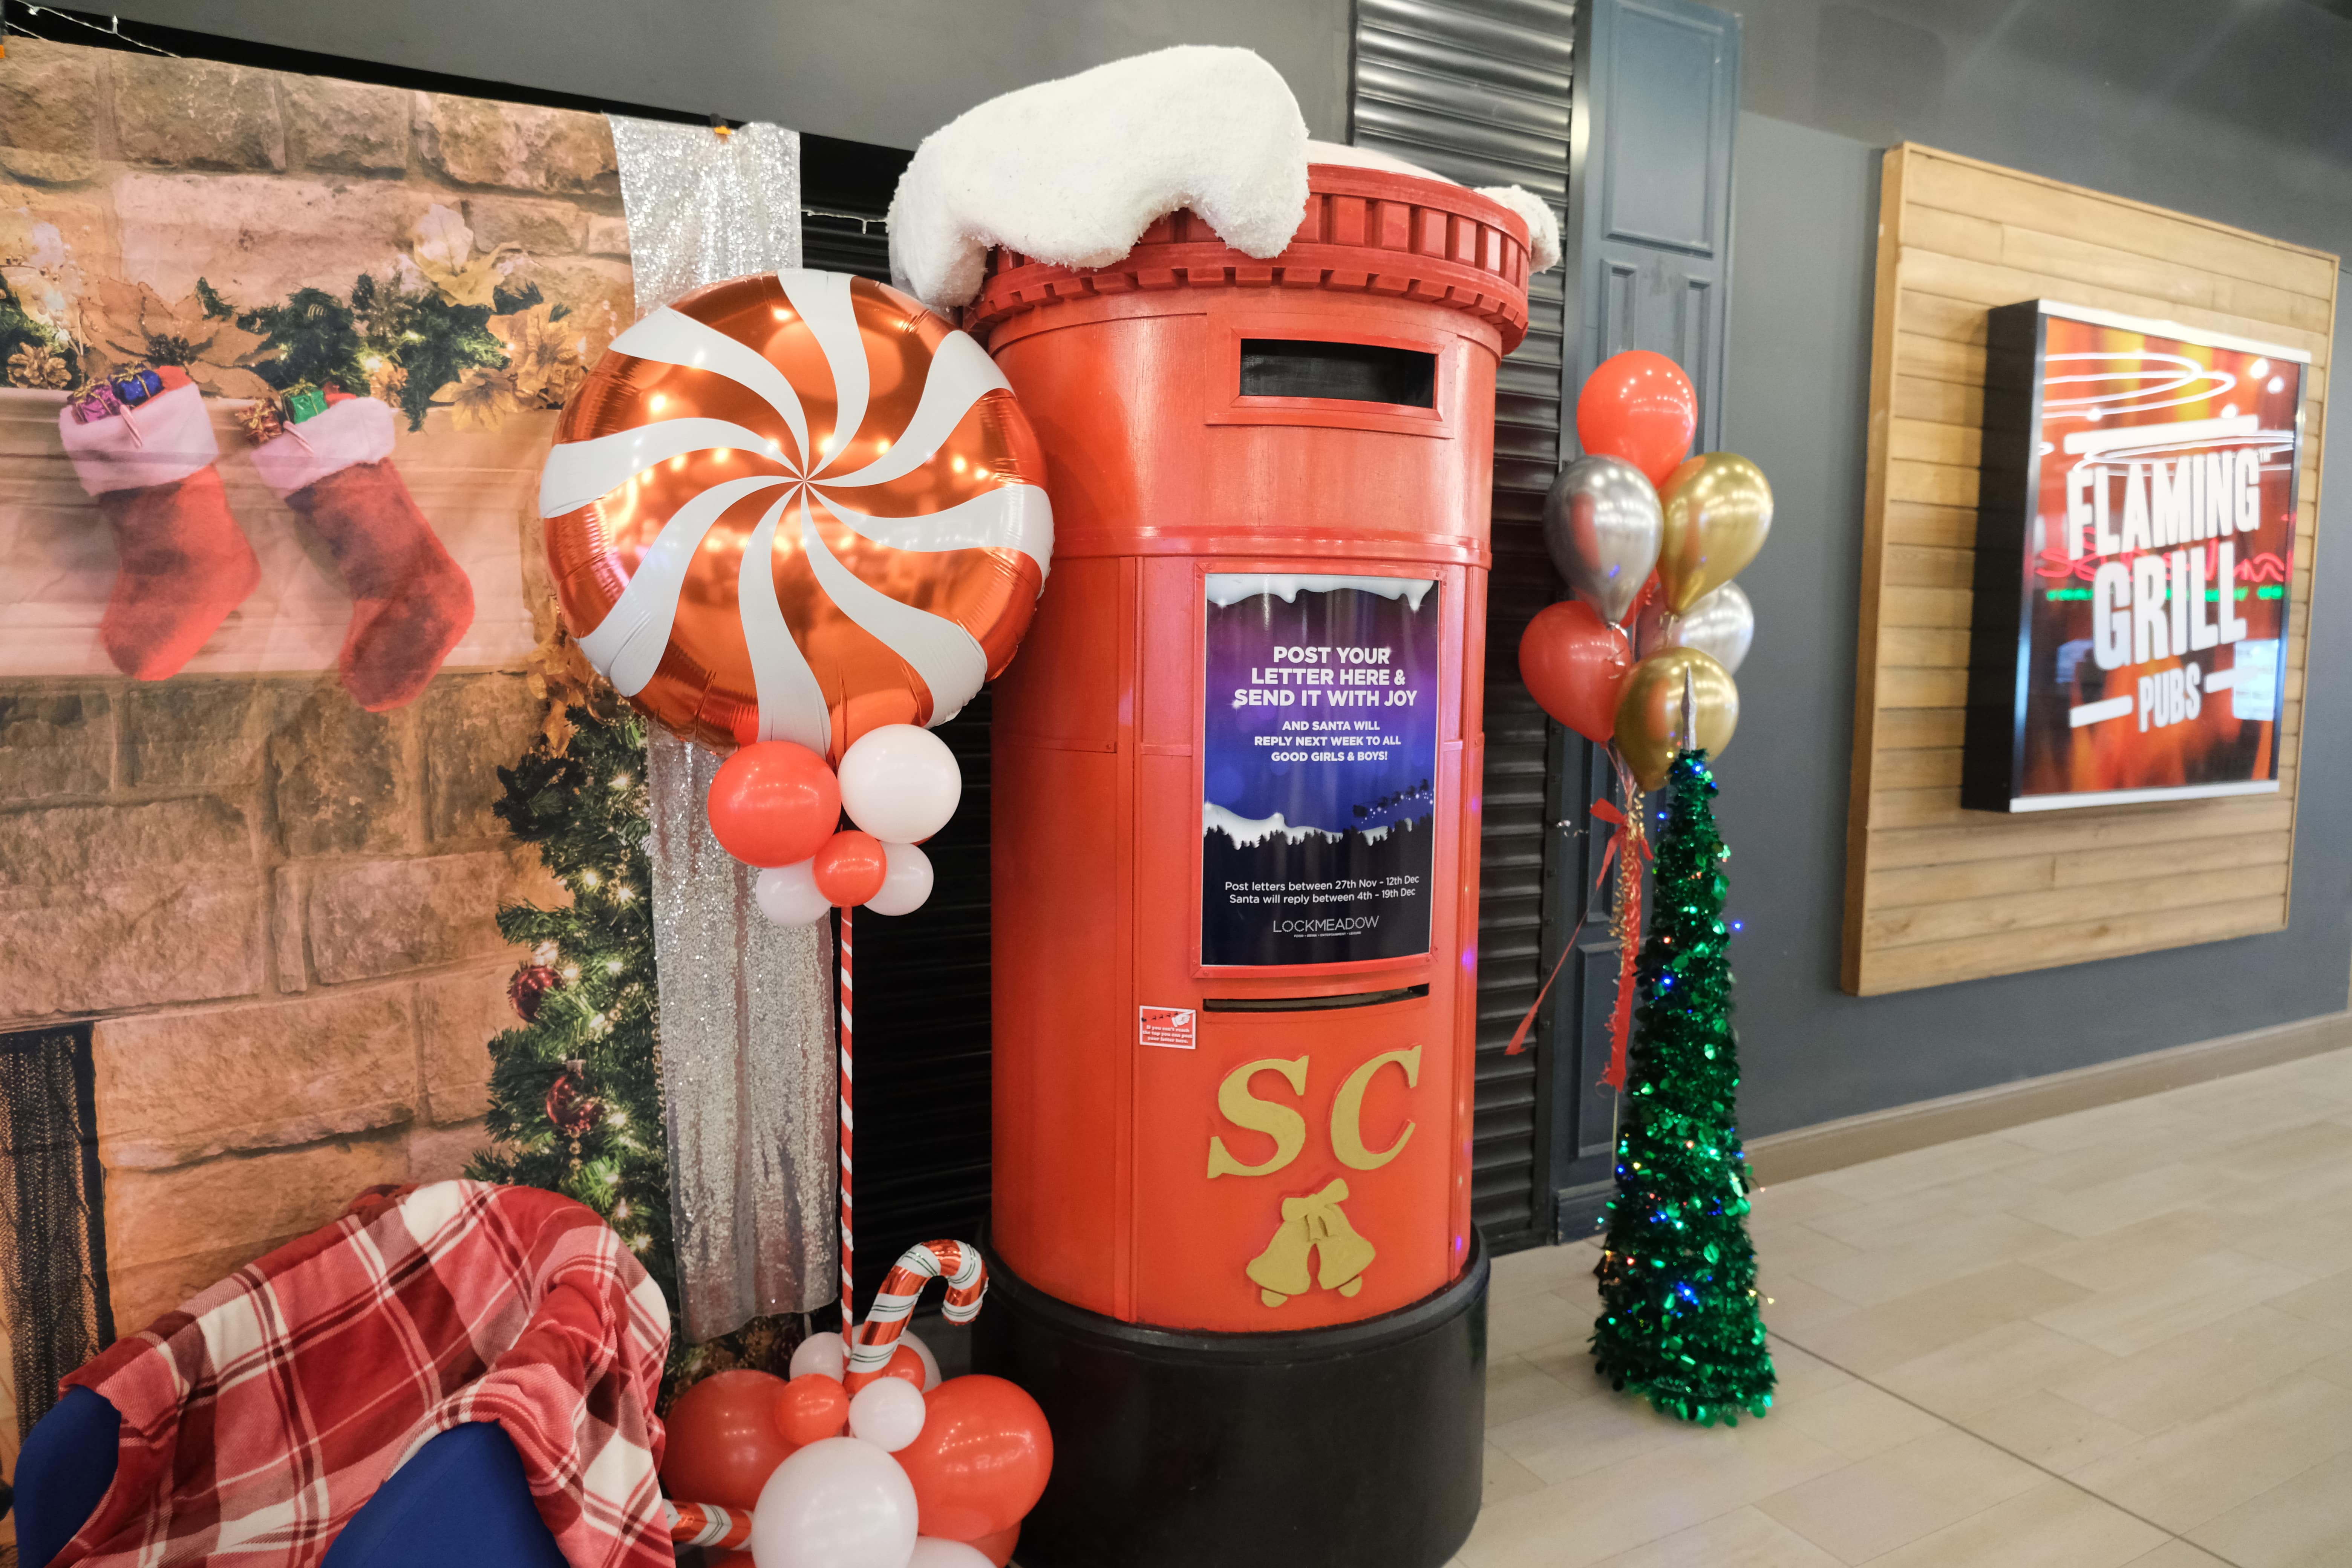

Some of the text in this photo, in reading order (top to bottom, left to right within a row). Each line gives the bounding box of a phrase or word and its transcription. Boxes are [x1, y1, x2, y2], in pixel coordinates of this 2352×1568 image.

[2066, 448, 2261, 560] FLAMING
[2092, 541, 2246, 672] GRILL
[1274, 646, 1390, 664] POST YOUR
[1252, 668, 1406, 685] LETTER HERE &
[1234, 689, 1417, 706] SEND IT WITH JOY
[2138, 662, 2201, 733] PUBS
[1282, 721, 1380, 730] AND SANTA WILL
[1254, 736, 1401, 746] REPLY NEXT WEEK TO ALL
[1271, 751, 1387, 761] GOOD GIRLS & BOYS!
[1225, 881, 1249, 891] Post
[1252, 881, 1286, 891] letters
[1288, 881, 1332, 891] between
[1335, 879, 1356, 890] 27th
[1359, 879, 1377, 888] Nov
[1386, 876, 1402, 886] 12th
[1404, 875, 1419, 884] Dec
[1230, 894, 1260, 903] Santa
[1263, 894, 1280, 903] will
[1283, 894, 1310, 905] reply
[1312, 893, 1355, 903] between
[1357, 891, 1372, 900] 4th
[1381, 889, 1398, 899] 19th
[1400, 888, 1416, 897] Dec
[1273, 915, 1380, 933] LOCKMEADOW
